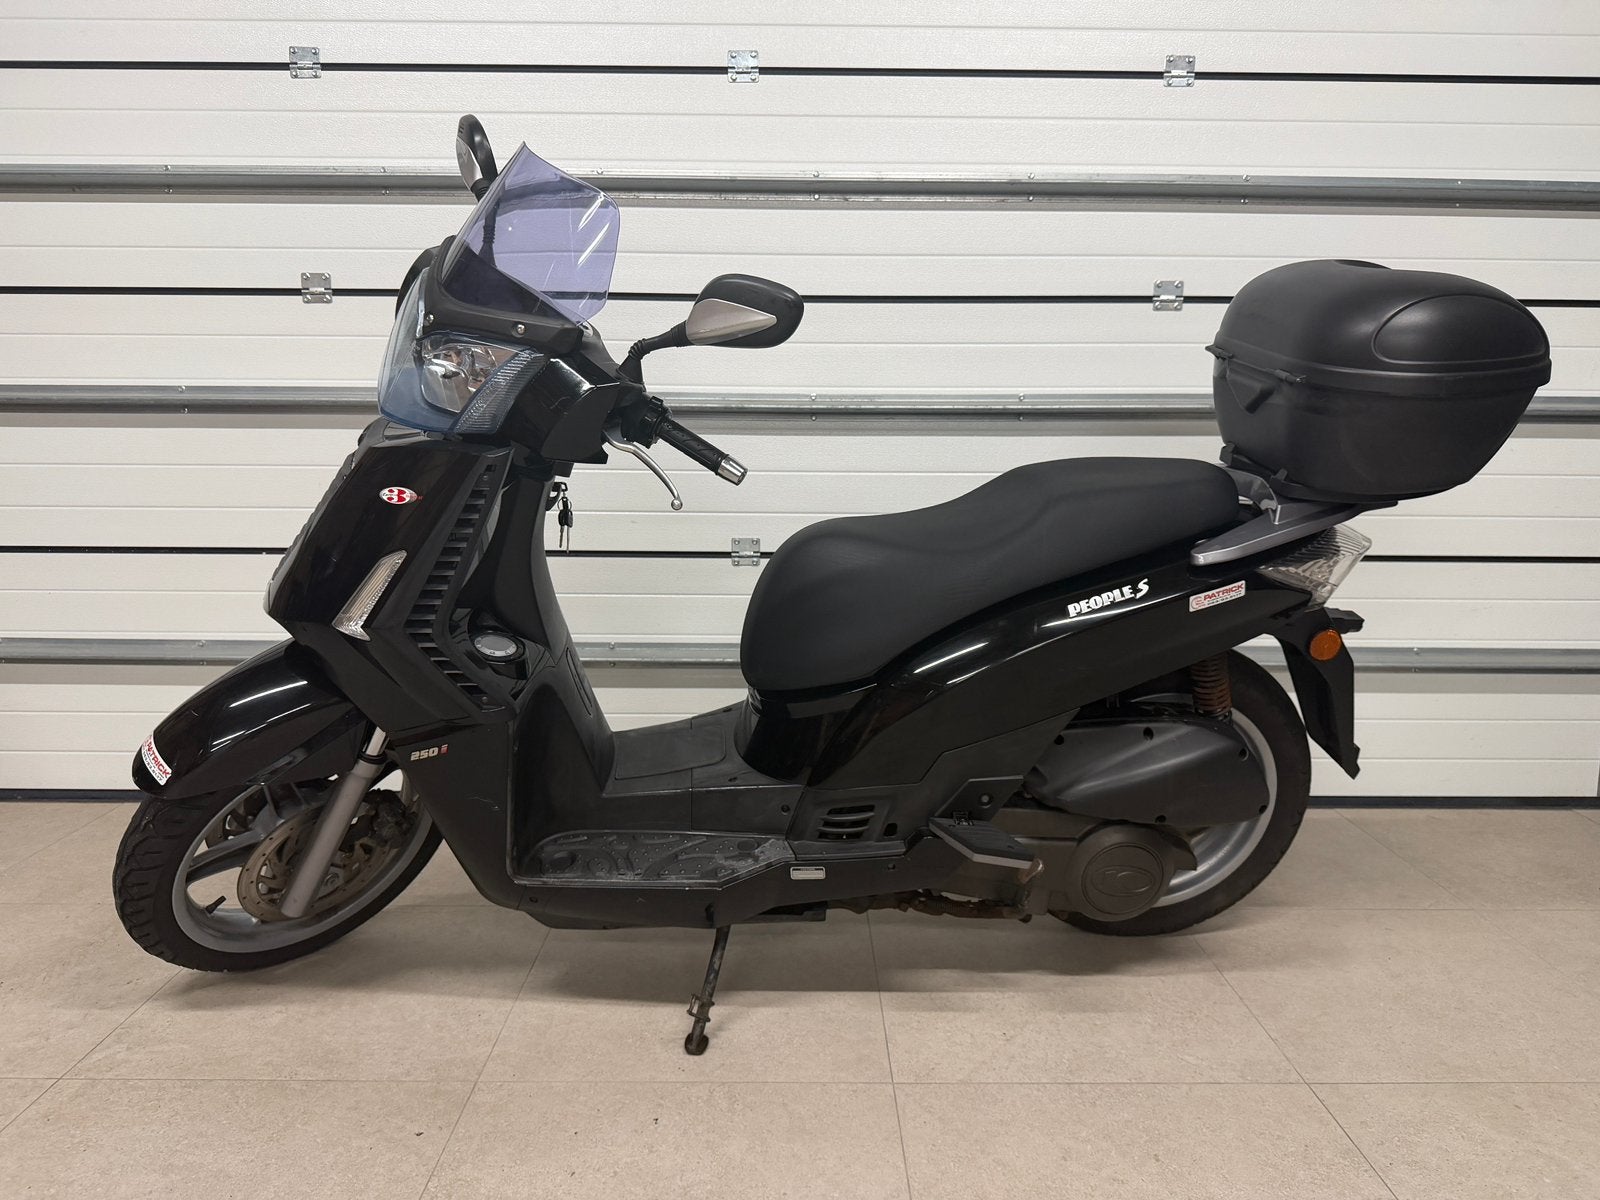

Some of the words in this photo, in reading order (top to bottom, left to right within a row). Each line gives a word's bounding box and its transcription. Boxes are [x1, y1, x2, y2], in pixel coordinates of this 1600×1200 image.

[1067, 585, 1135, 617] PEOPLE
[1136, 578, 1149, 599] S
[1204, 583, 1244, 600] PATRICK
[147, 741, 171, 779] PATRICK
